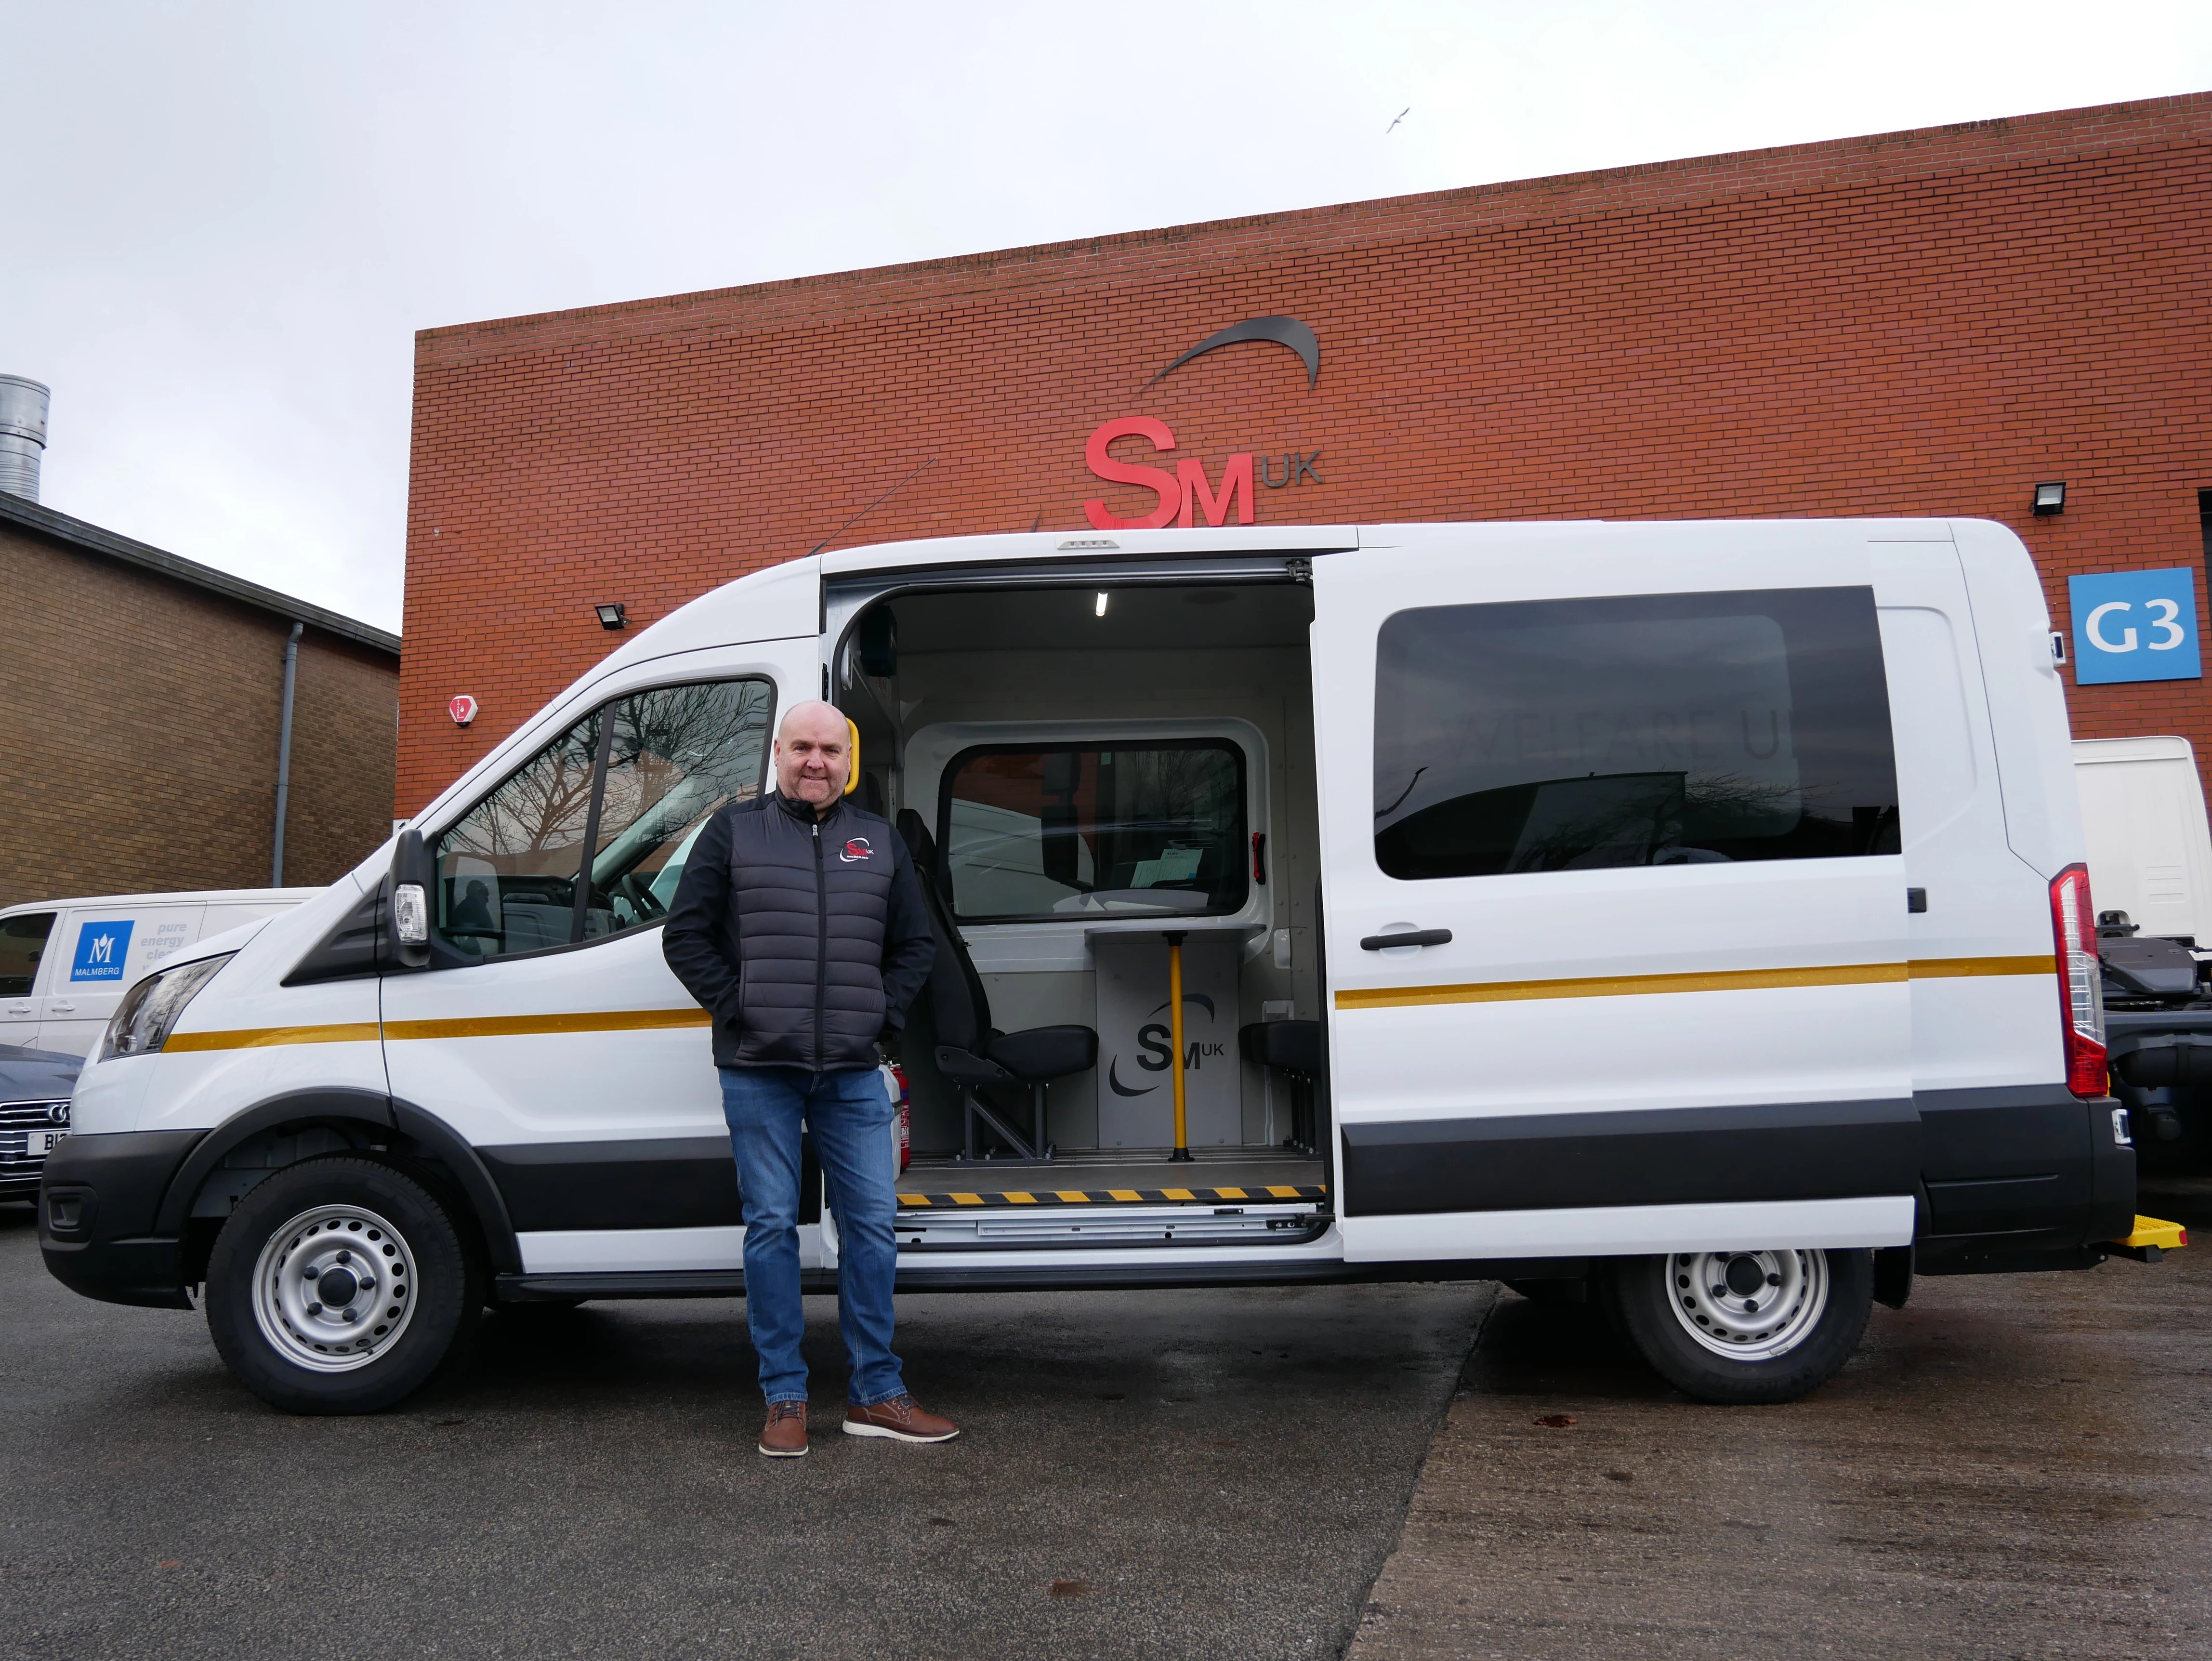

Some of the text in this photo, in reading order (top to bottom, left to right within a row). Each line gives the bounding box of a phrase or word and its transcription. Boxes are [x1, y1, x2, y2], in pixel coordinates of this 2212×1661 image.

[1084, 416, 1324, 530] SM UK
[2086, 598, 2185, 653] G3
[1441, 710, 1718, 764] WELFARE
[846, 843, 868, 856] SM
[157, 923, 186, 935] pure
[141, 936, 184, 948] energy
[75, 967, 119, 976] MALMBERG
[1202, 1043, 1224, 1056] UK
